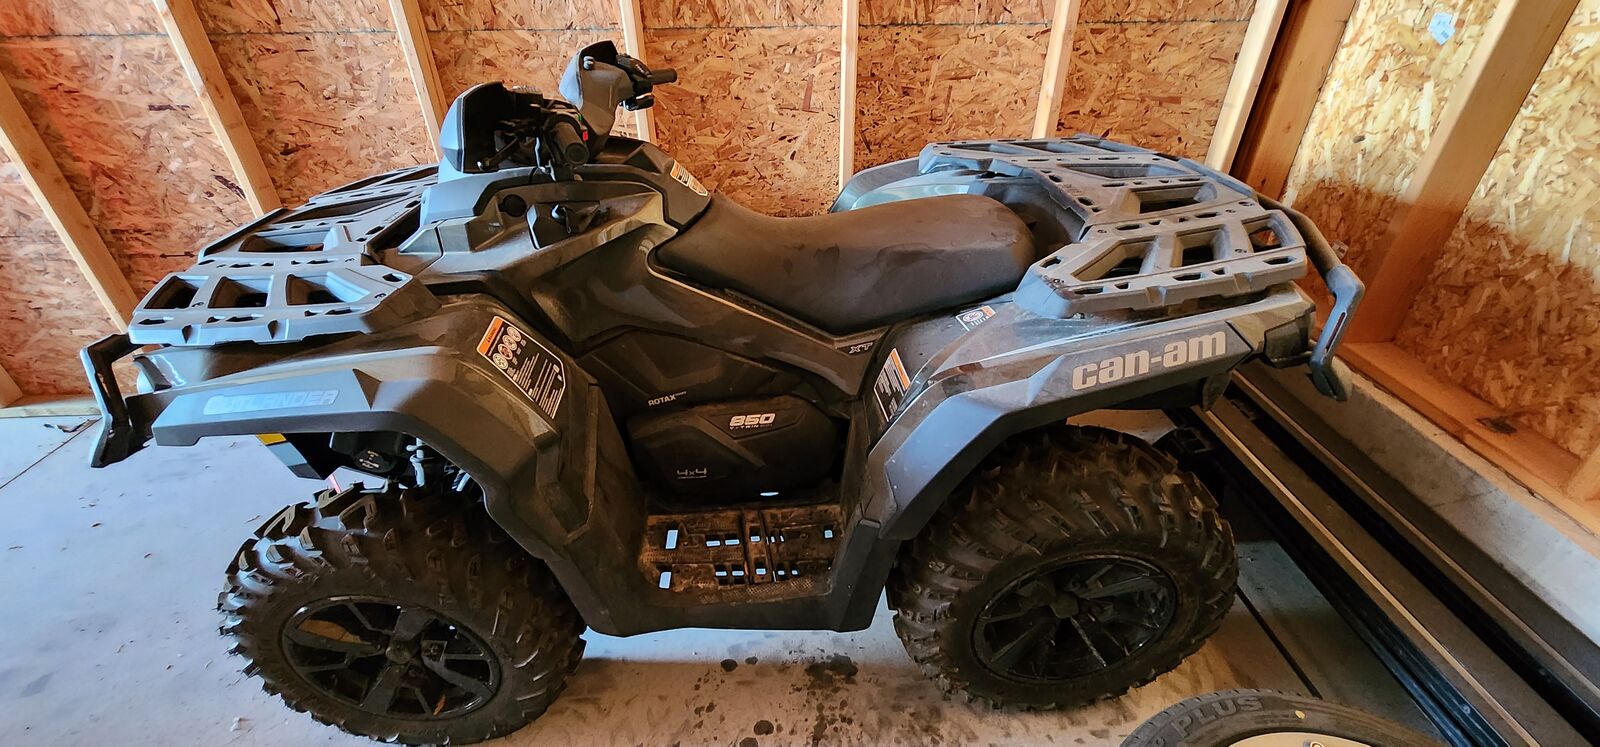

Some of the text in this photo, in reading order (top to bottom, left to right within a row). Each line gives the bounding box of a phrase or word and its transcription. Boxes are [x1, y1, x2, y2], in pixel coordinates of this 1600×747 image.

[849, 342, 873, 354] XT
[1072, 331, 1226, 390] can-am
[648, 394, 676, 407] ROTAX
[729, 413, 776, 426] 850
[1171, 697, 1262, 737] PLUS
